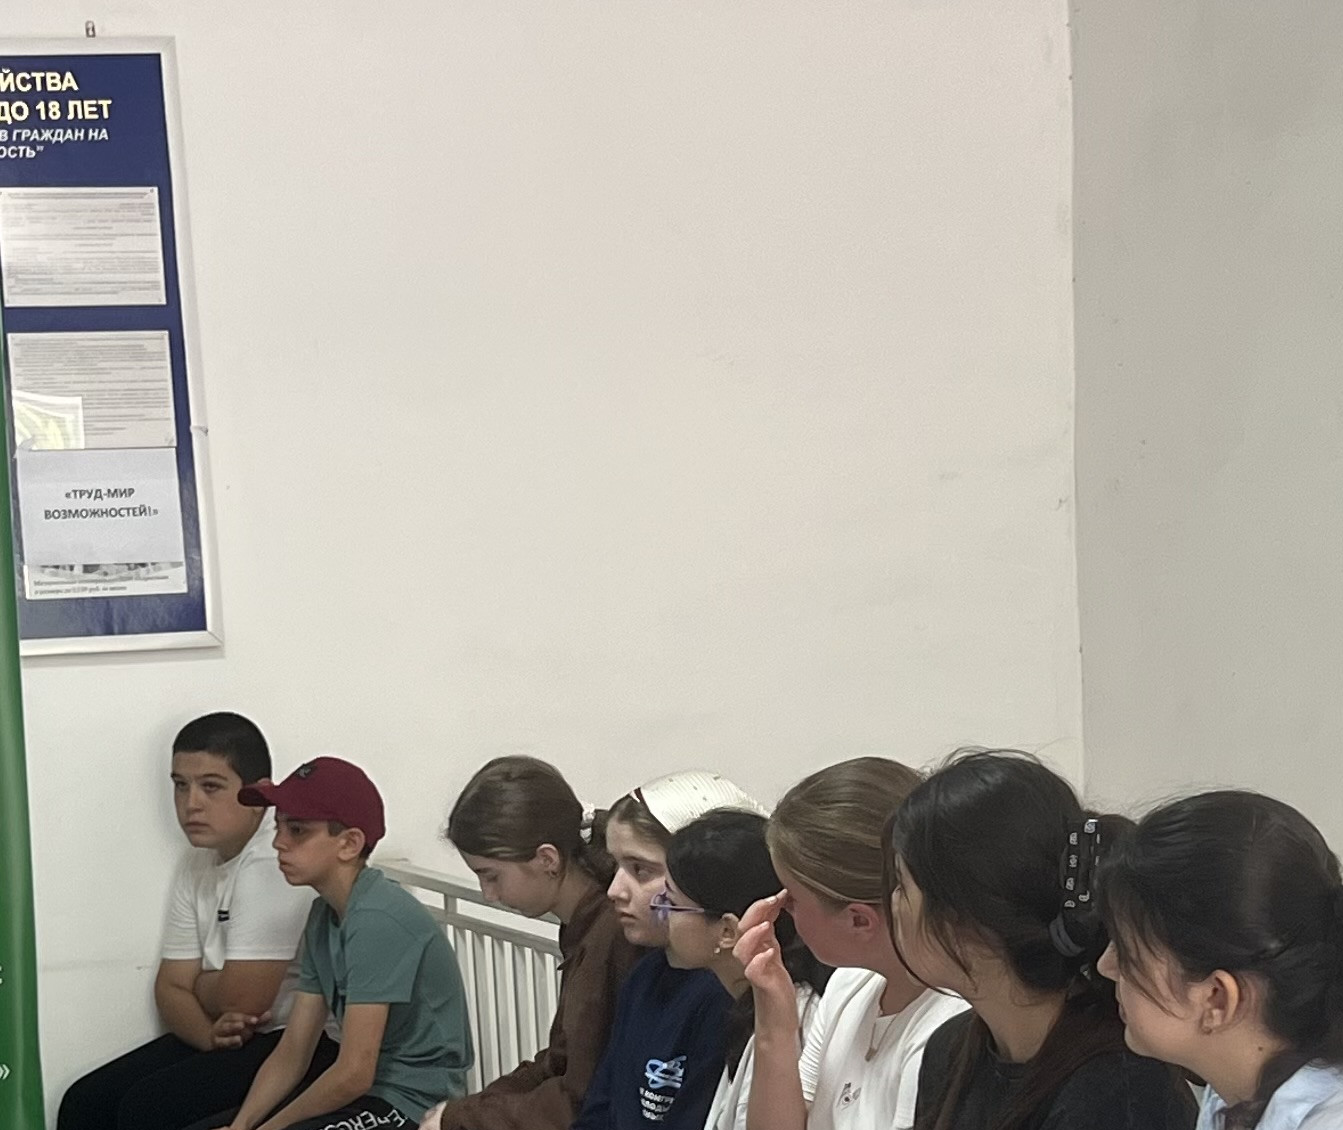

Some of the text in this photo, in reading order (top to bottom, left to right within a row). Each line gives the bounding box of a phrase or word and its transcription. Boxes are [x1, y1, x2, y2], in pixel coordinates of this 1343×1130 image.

[35, 102, 61, 120] 18
[67, 100, 111, 120] ЛЕТ
[12, 129, 83, 144] ГРАЖДАН
[88, 128, 108, 141] НА
[65, 487, 135, 501] «ТРУД-МИР
[44, 504, 158, 520] ВОЗМОЖНОСТЕЙ!»
